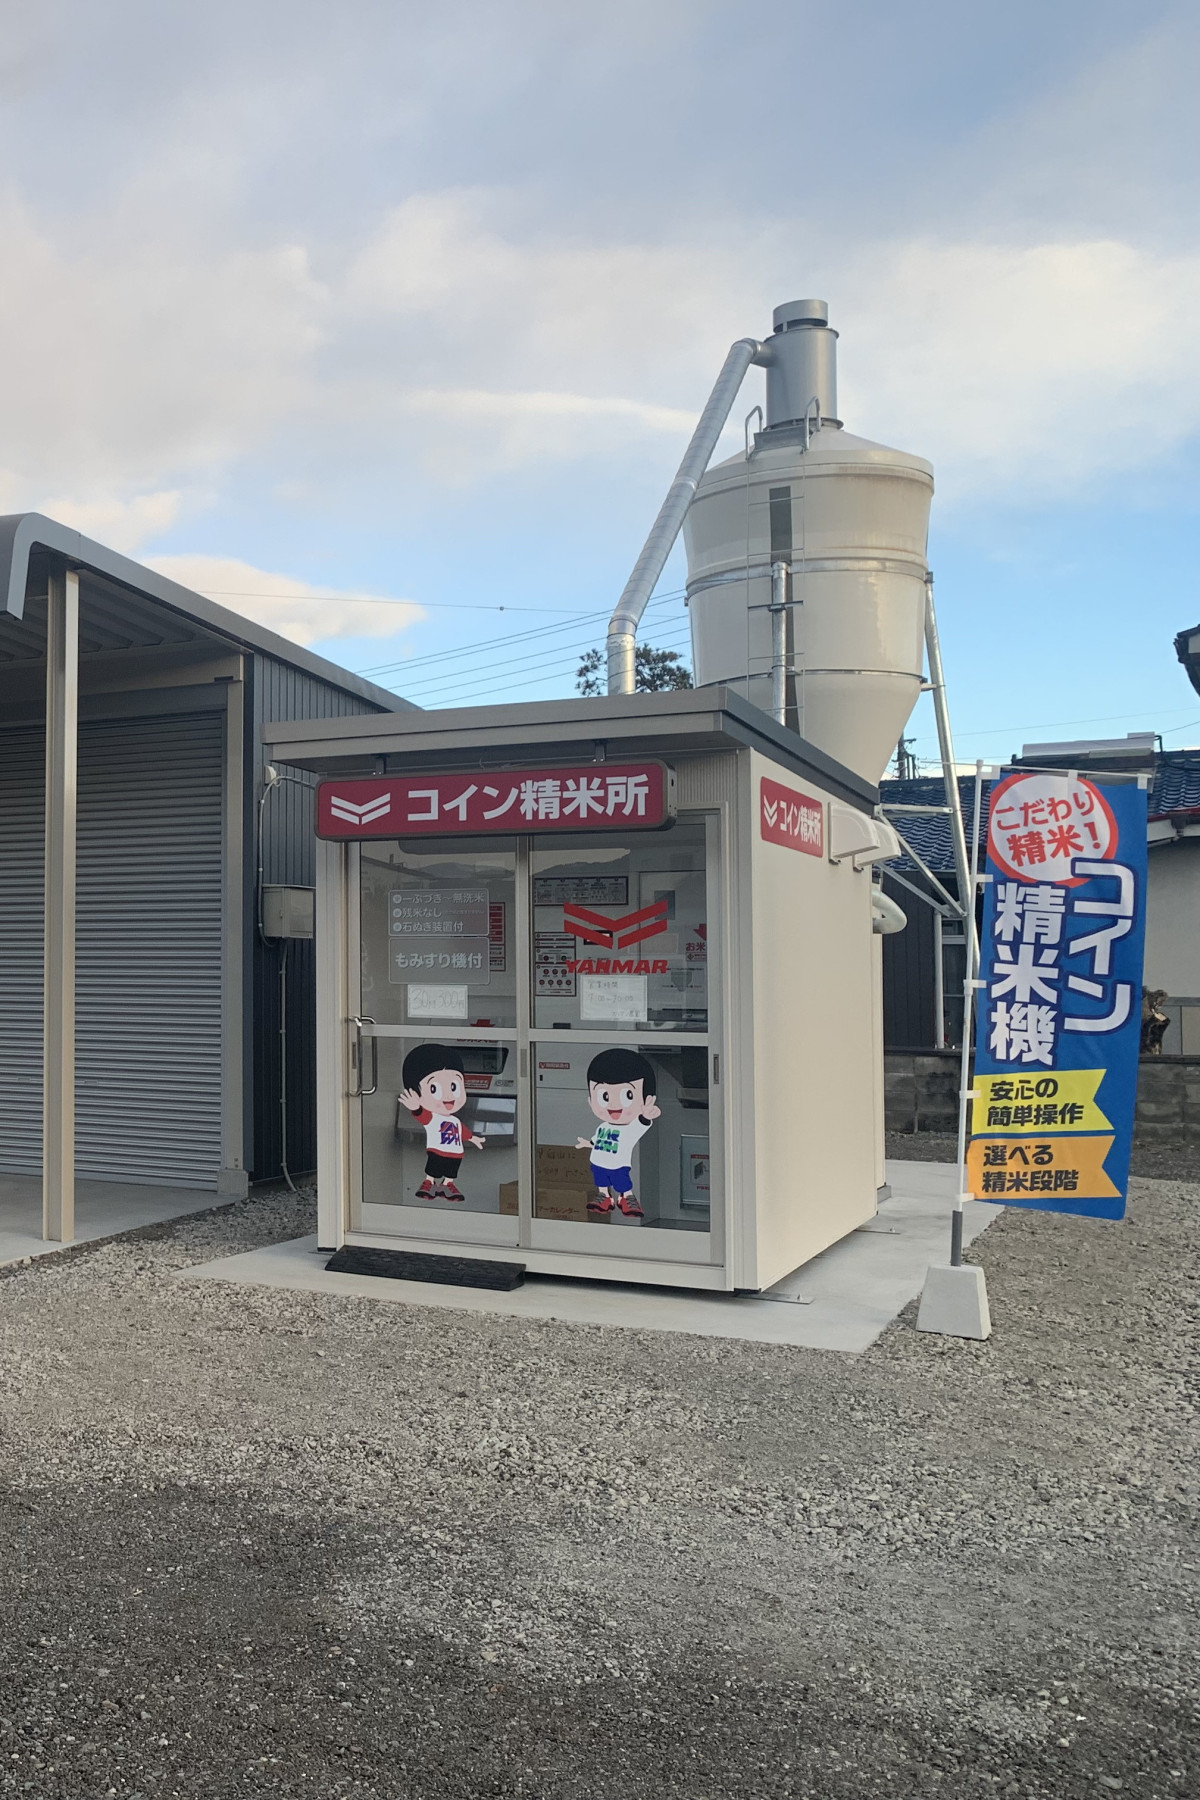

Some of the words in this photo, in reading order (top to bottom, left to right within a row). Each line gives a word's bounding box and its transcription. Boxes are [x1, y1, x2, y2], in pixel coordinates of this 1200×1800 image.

[407, 773, 649, 822] コイン精米所
[995, 790, 1095, 831] こだわり
[780, 800, 821, 848] コイン精米所
[1006, 821, 1102, 867] 精米!
[402, 907, 442, 918] 残米なし
[402, 921, 464, 933] 石ぬき装置付
[1062, 858, 1136, 1034] コイン
[395, 952, 483, 969] もみすり機付
[566, 959, 668, 975] YANMAR
[989, 880, 1066, 1067] 精米機
[989, 1078, 1059, 1102] 安心の
[987, 1102, 1085, 1127] 簡単操作
[983, 1144, 1054, 1167] 選べる
[981, 1169, 1080, 1193] 精米段階
